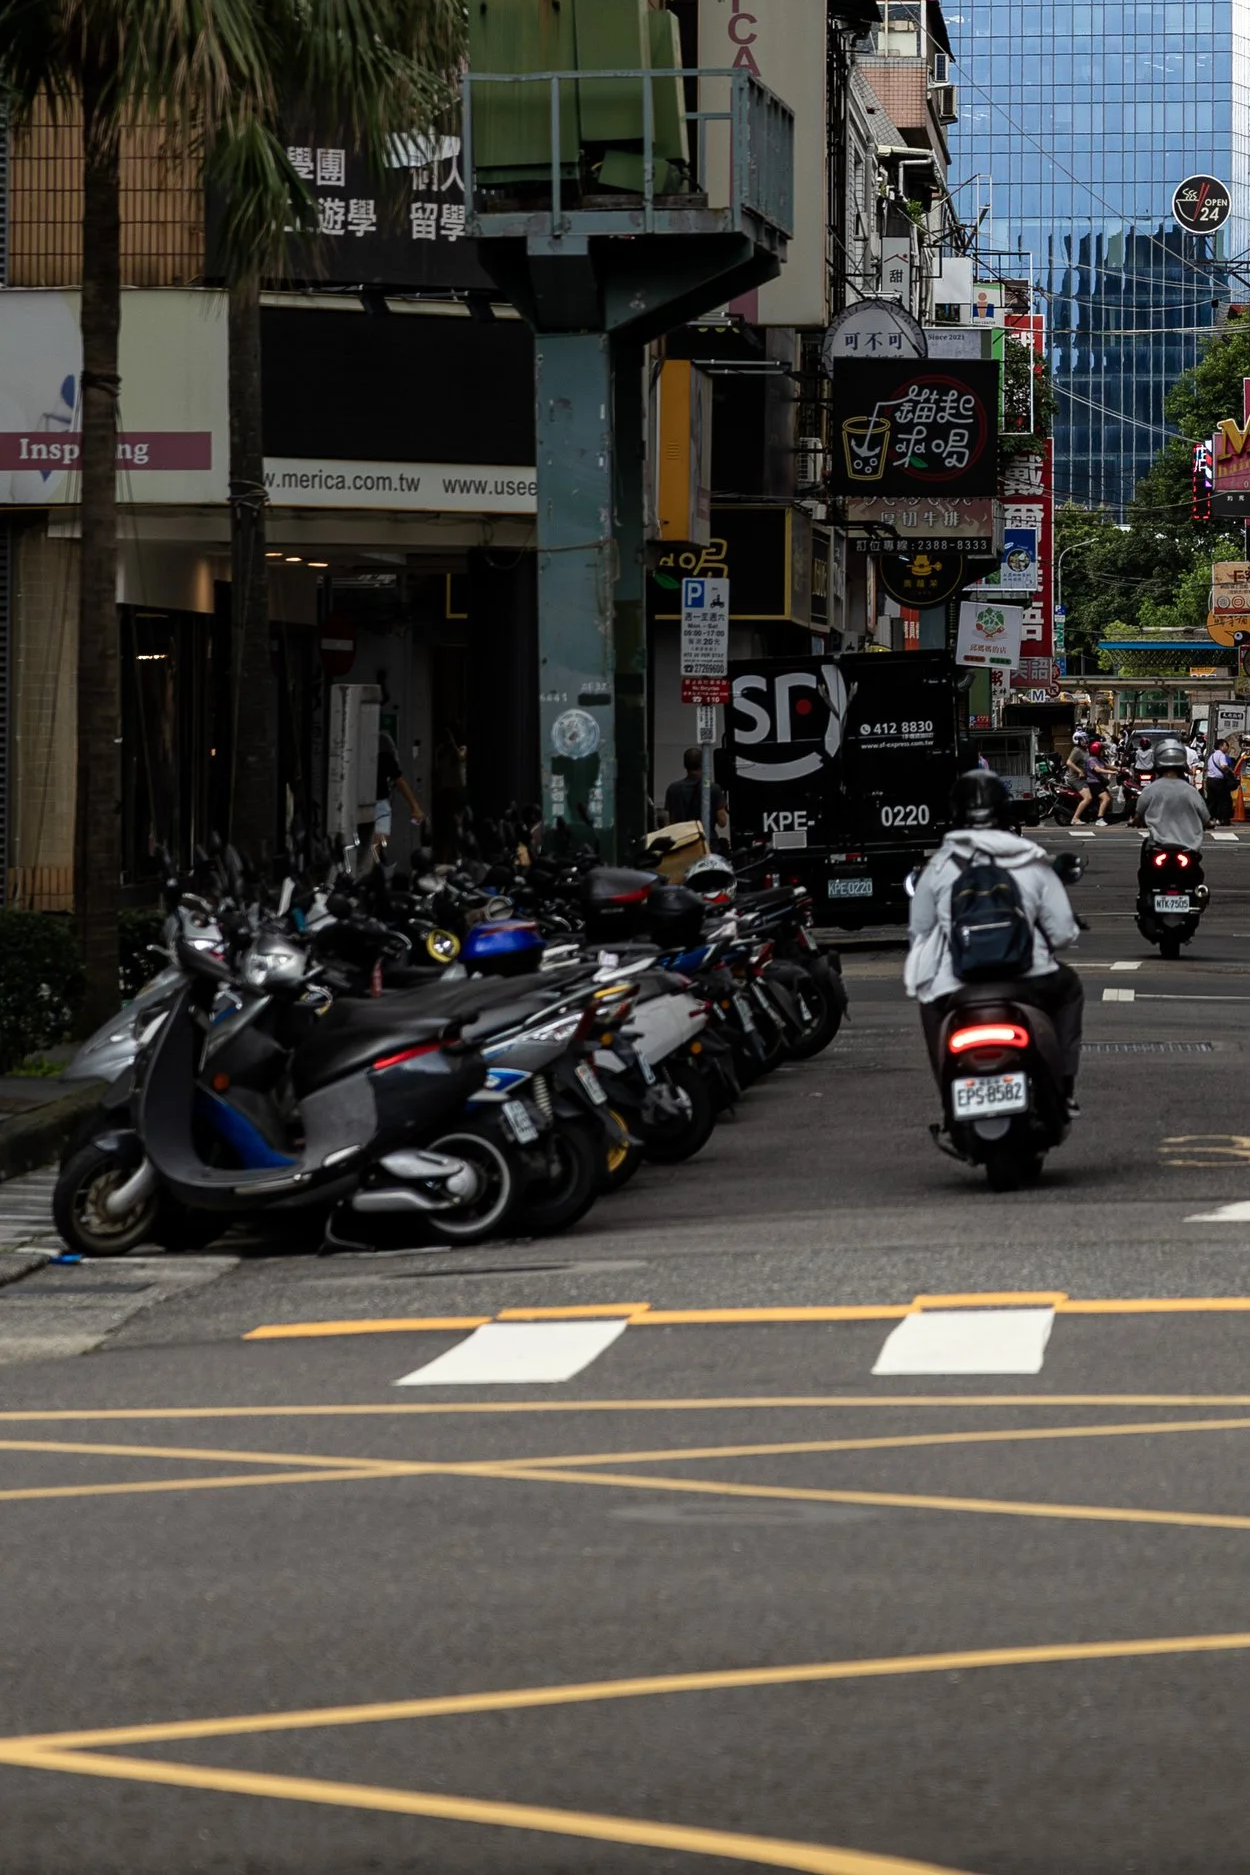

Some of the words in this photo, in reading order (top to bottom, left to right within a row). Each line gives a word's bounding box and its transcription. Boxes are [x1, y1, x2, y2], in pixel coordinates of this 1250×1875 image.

[1204, 197, 1228, 208] OPEN
[410, 201, 466, 243] 留學
[1200, 205, 1220, 222] 24
[843, 331, 905, 351] 可不可
[18, 437, 150, 469] Inspng
[880, 510, 961, 527] 厚切牛排
[873, 721, 898, 735] 412
[900, 719, 934, 734] 8830
[860, 739, 934, 750] www.sf-express.com.tw
[880, 804, 931, 828] 0220
[957, 1081, 1024, 1109] EPS-8582
